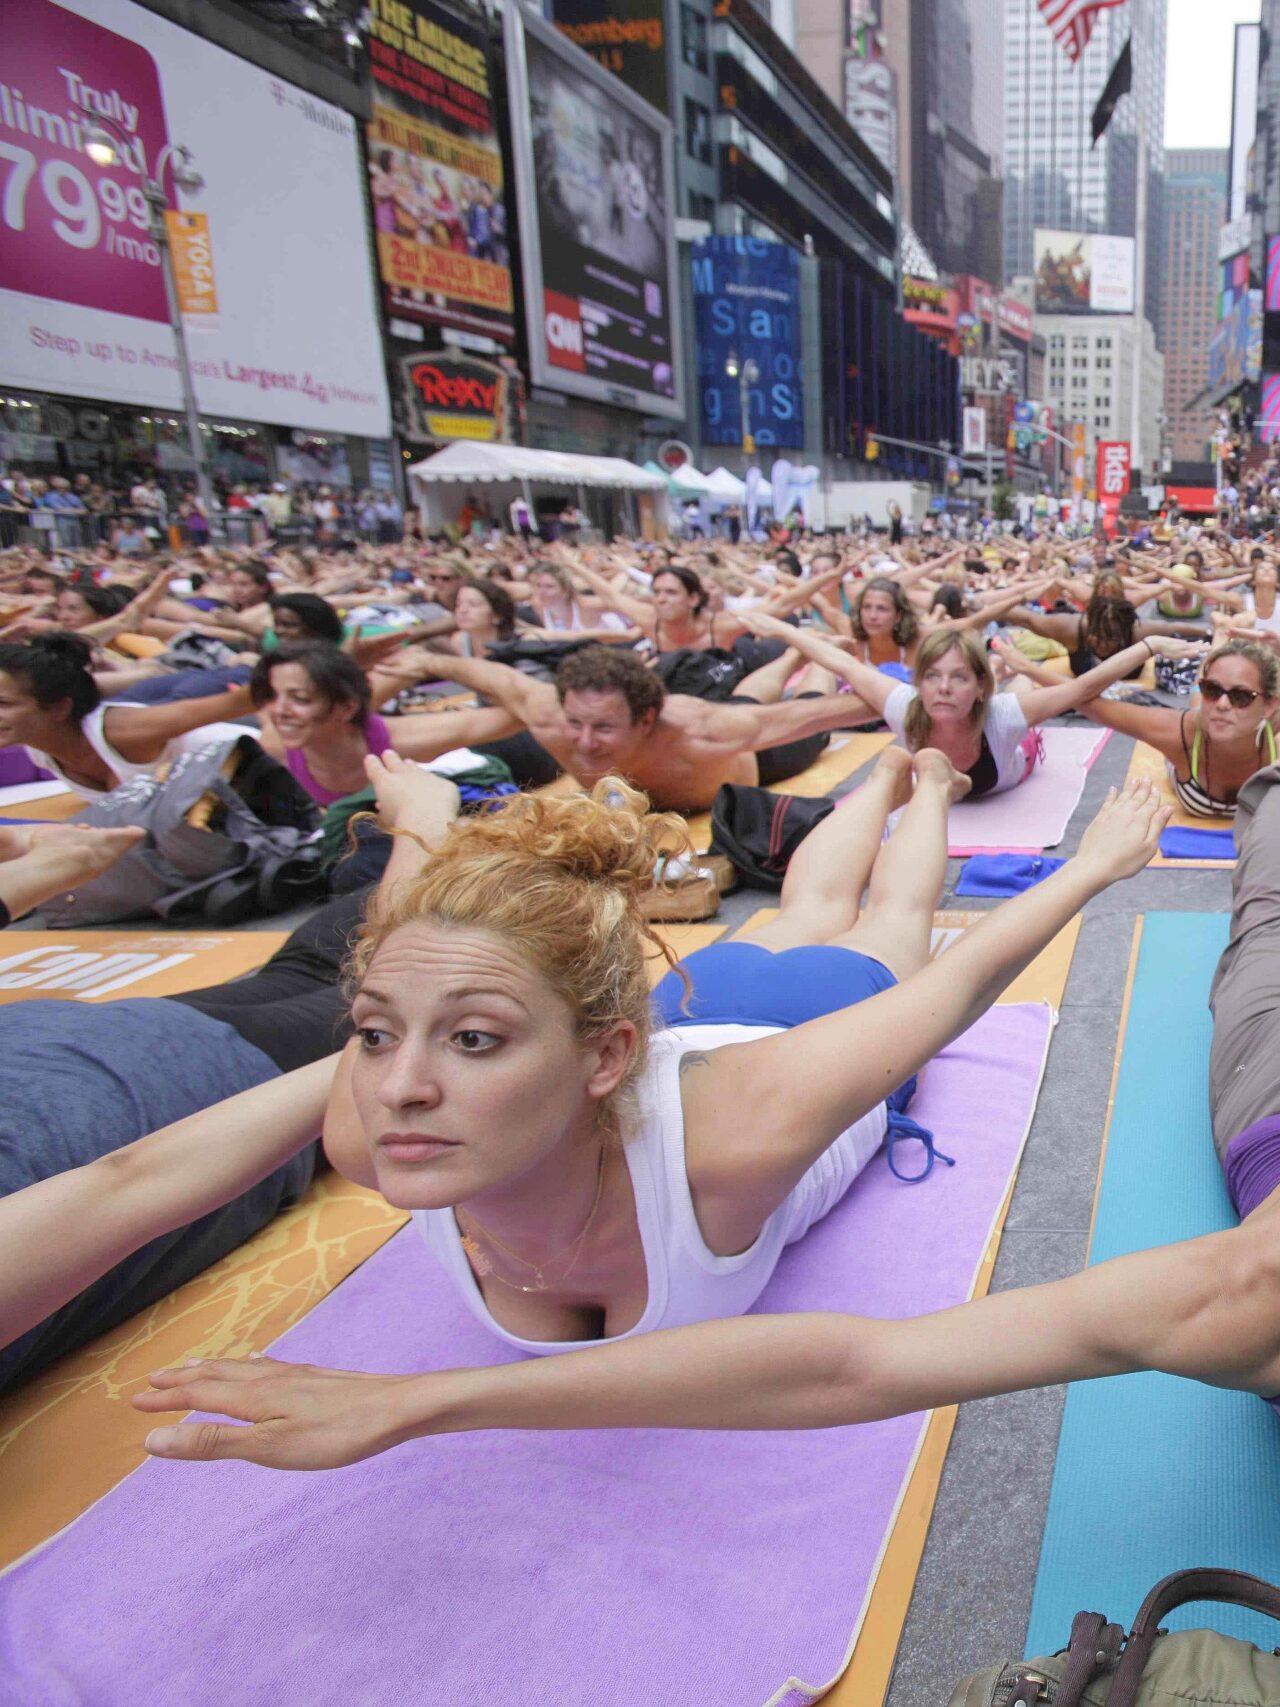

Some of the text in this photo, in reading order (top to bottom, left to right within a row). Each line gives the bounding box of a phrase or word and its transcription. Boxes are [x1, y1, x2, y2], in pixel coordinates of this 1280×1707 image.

[416, 14, 487, 79] MUSIC
[57, 66, 140, 133] Truly
[187, 232, 213, 296] YOGA
[30, 326, 81, 357] Step
[84, 341, 112, 362] up
[116, 344, 138, 364] to
[1103, 444, 1130, 495] tkts
